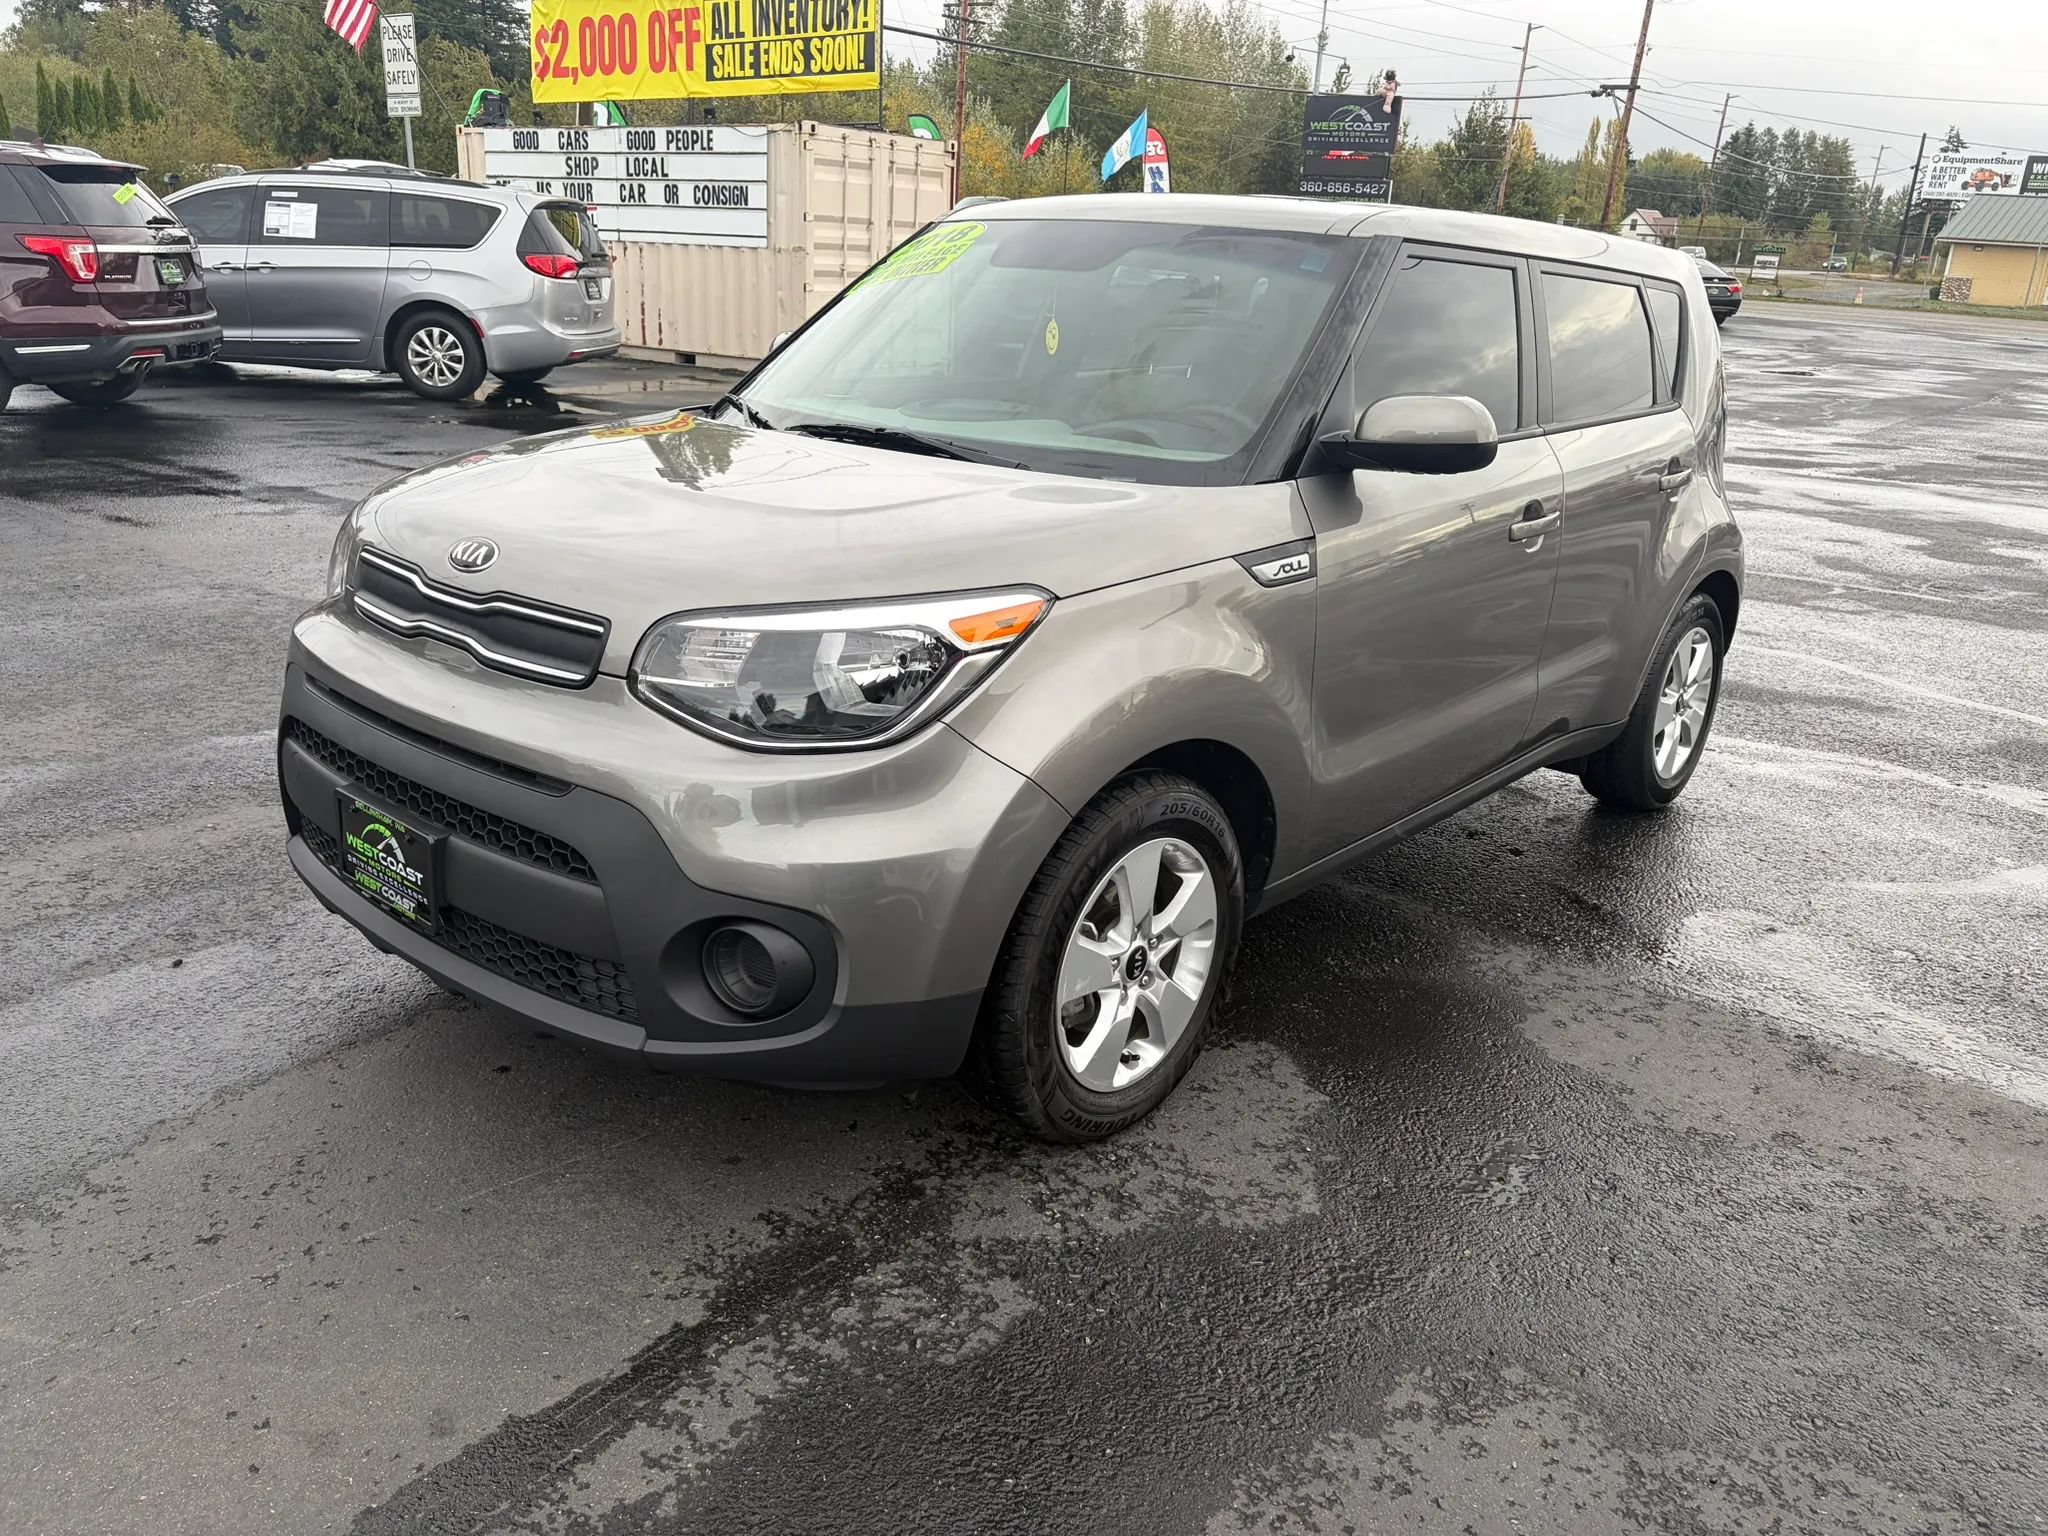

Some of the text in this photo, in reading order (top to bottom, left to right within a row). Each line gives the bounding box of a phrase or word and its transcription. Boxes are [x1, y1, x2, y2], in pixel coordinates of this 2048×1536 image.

[711, 0, 869, 40] ALL INVENTORY!
[382, 24, 413, 40] PLEASE
[386, 47, 413, 63] DRIVE
[534, 7, 701, 86] $2,000 OFF
[712, 33, 865, 79] SALE ENDS SOON!
[386, 70, 416, 85] SAFELY
[1310, 121, 1391, 132] WESTCOAST
[512, 129, 714, 151] GOOD CARS GOOD PEOPLE
[565, 156, 669, 178] SHOP LOCAL
[1932, 166, 1967, 174] A BETTER
[1942, 155, 2024, 165] EquipmentShare
[1299, 181, 1387, 195] 360-656-5427
[1928, 181, 1948, 189] RENT
[1948, 174, 1957, 182] TO
[562, 182, 594, 202] YOUR
[620, 183, 647, 203] CAR
[664, 183, 679, 204] OR
[693, 184, 749, 206] CONSIGN
[452, 541, 489, 566] KIA
[1273, 559, 1308, 577] SOUL
[1159, 802, 1226, 838] 205/60R16
[346, 831, 423, 886] WESTCOAST
[368, 858, 402, 883] MOTORS
[355, 869, 416, 913] WESTCOAST
[1132, 949, 1143, 978] KIA
[1060, 1107, 1138, 1133] TOURING
